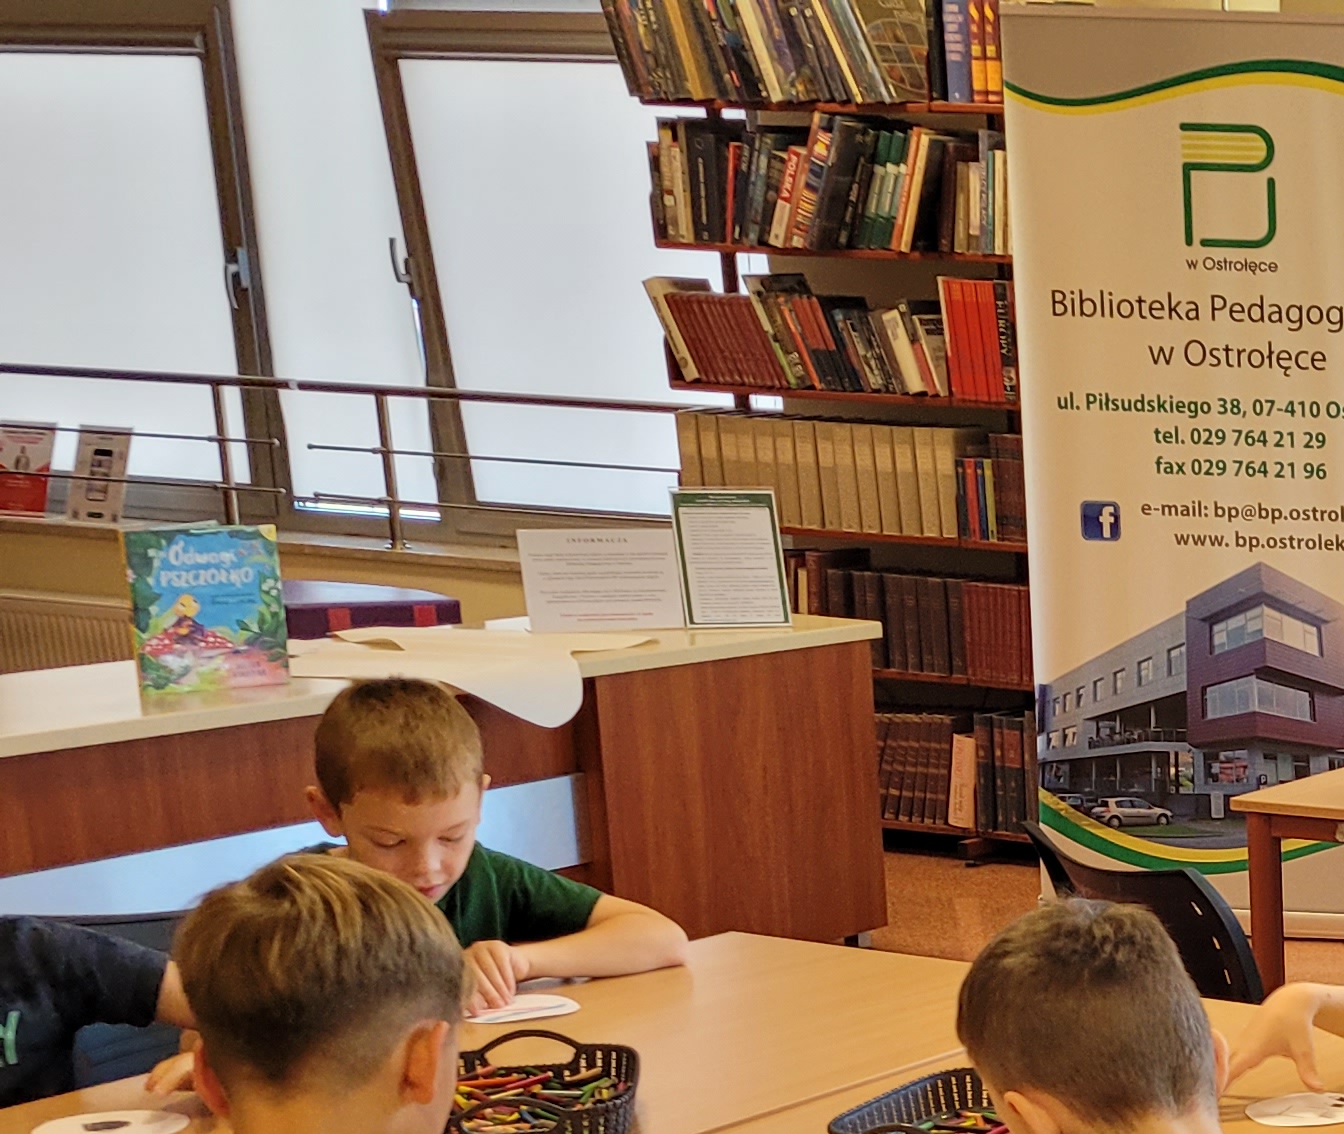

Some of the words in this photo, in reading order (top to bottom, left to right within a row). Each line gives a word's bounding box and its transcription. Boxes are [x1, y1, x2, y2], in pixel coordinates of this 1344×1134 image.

[780, 152, 799, 199] POLSKA
[1185, 258, 1198, 271] w
[1202, 256, 1279, 276] Ostrołęce
[1050, 289, 1200, 322] Biblioteka
[1148, 344, 1175, 366] w
[1184, 339, 1328, 377] Ostrołęce
[1056, 393, 1081, 411] ul.
[1086, 393, 1212, 418] Piłsudskiego
[1216, 398, 1248, 418] 38,
[1252, 398, 1321, 419] 07-410
[1154, 427, 1185, 446] tel.
[1190, 428, 1226, 447] 029
[1232, 429, 1268, 448] 764
[1273, 430, 1295, 449] 21
[1302, 431, 1327, 450] 29
[1155, 456, 1186, 477] fax
[1190, 458, 1226, 477] 029
[1232, 459, 1268, 478] 764
[1273, 460, 1295, 479] 21
[1303, 461, 1327, 480] 96
[1140, 500, 1209, 520] e-mail:
[1174, 531, 1230, 548] www.
